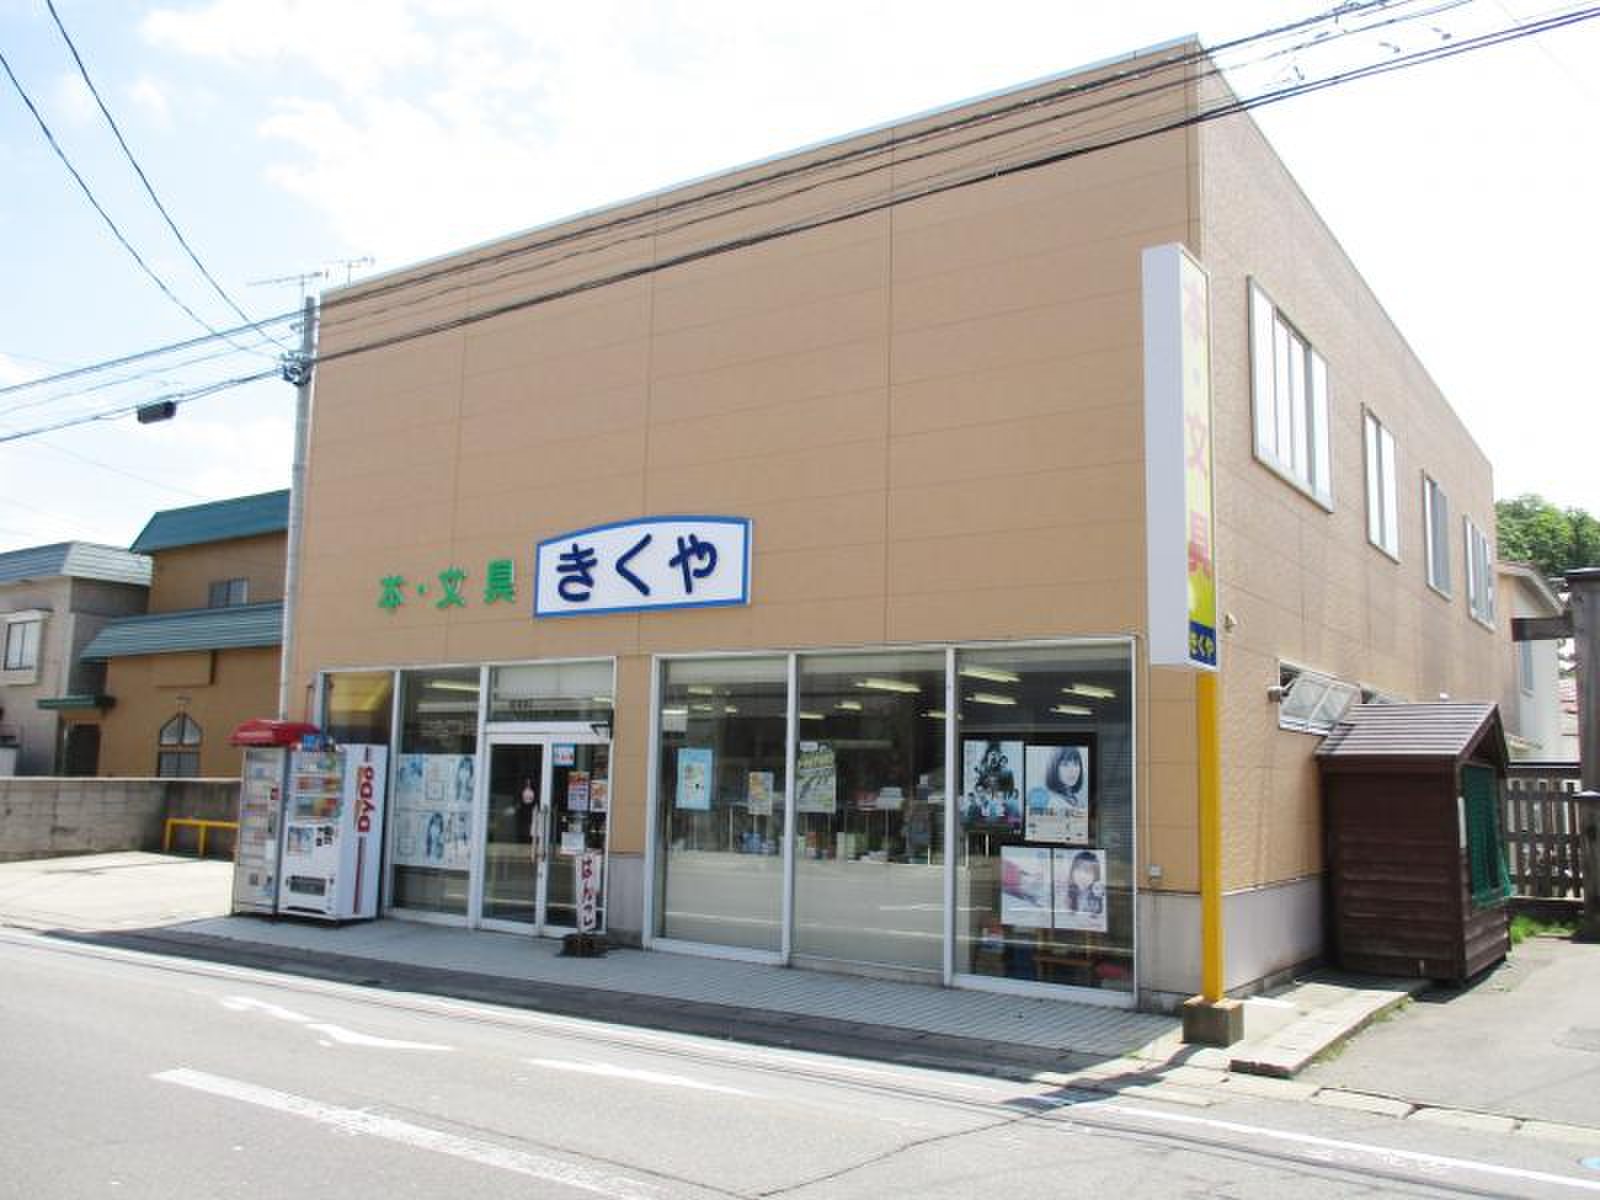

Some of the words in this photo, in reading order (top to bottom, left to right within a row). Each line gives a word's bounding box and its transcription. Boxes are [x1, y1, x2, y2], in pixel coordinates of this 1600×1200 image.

[556, 533, 718, 602] きくや
[357, 767, 375, 833] DyDo
